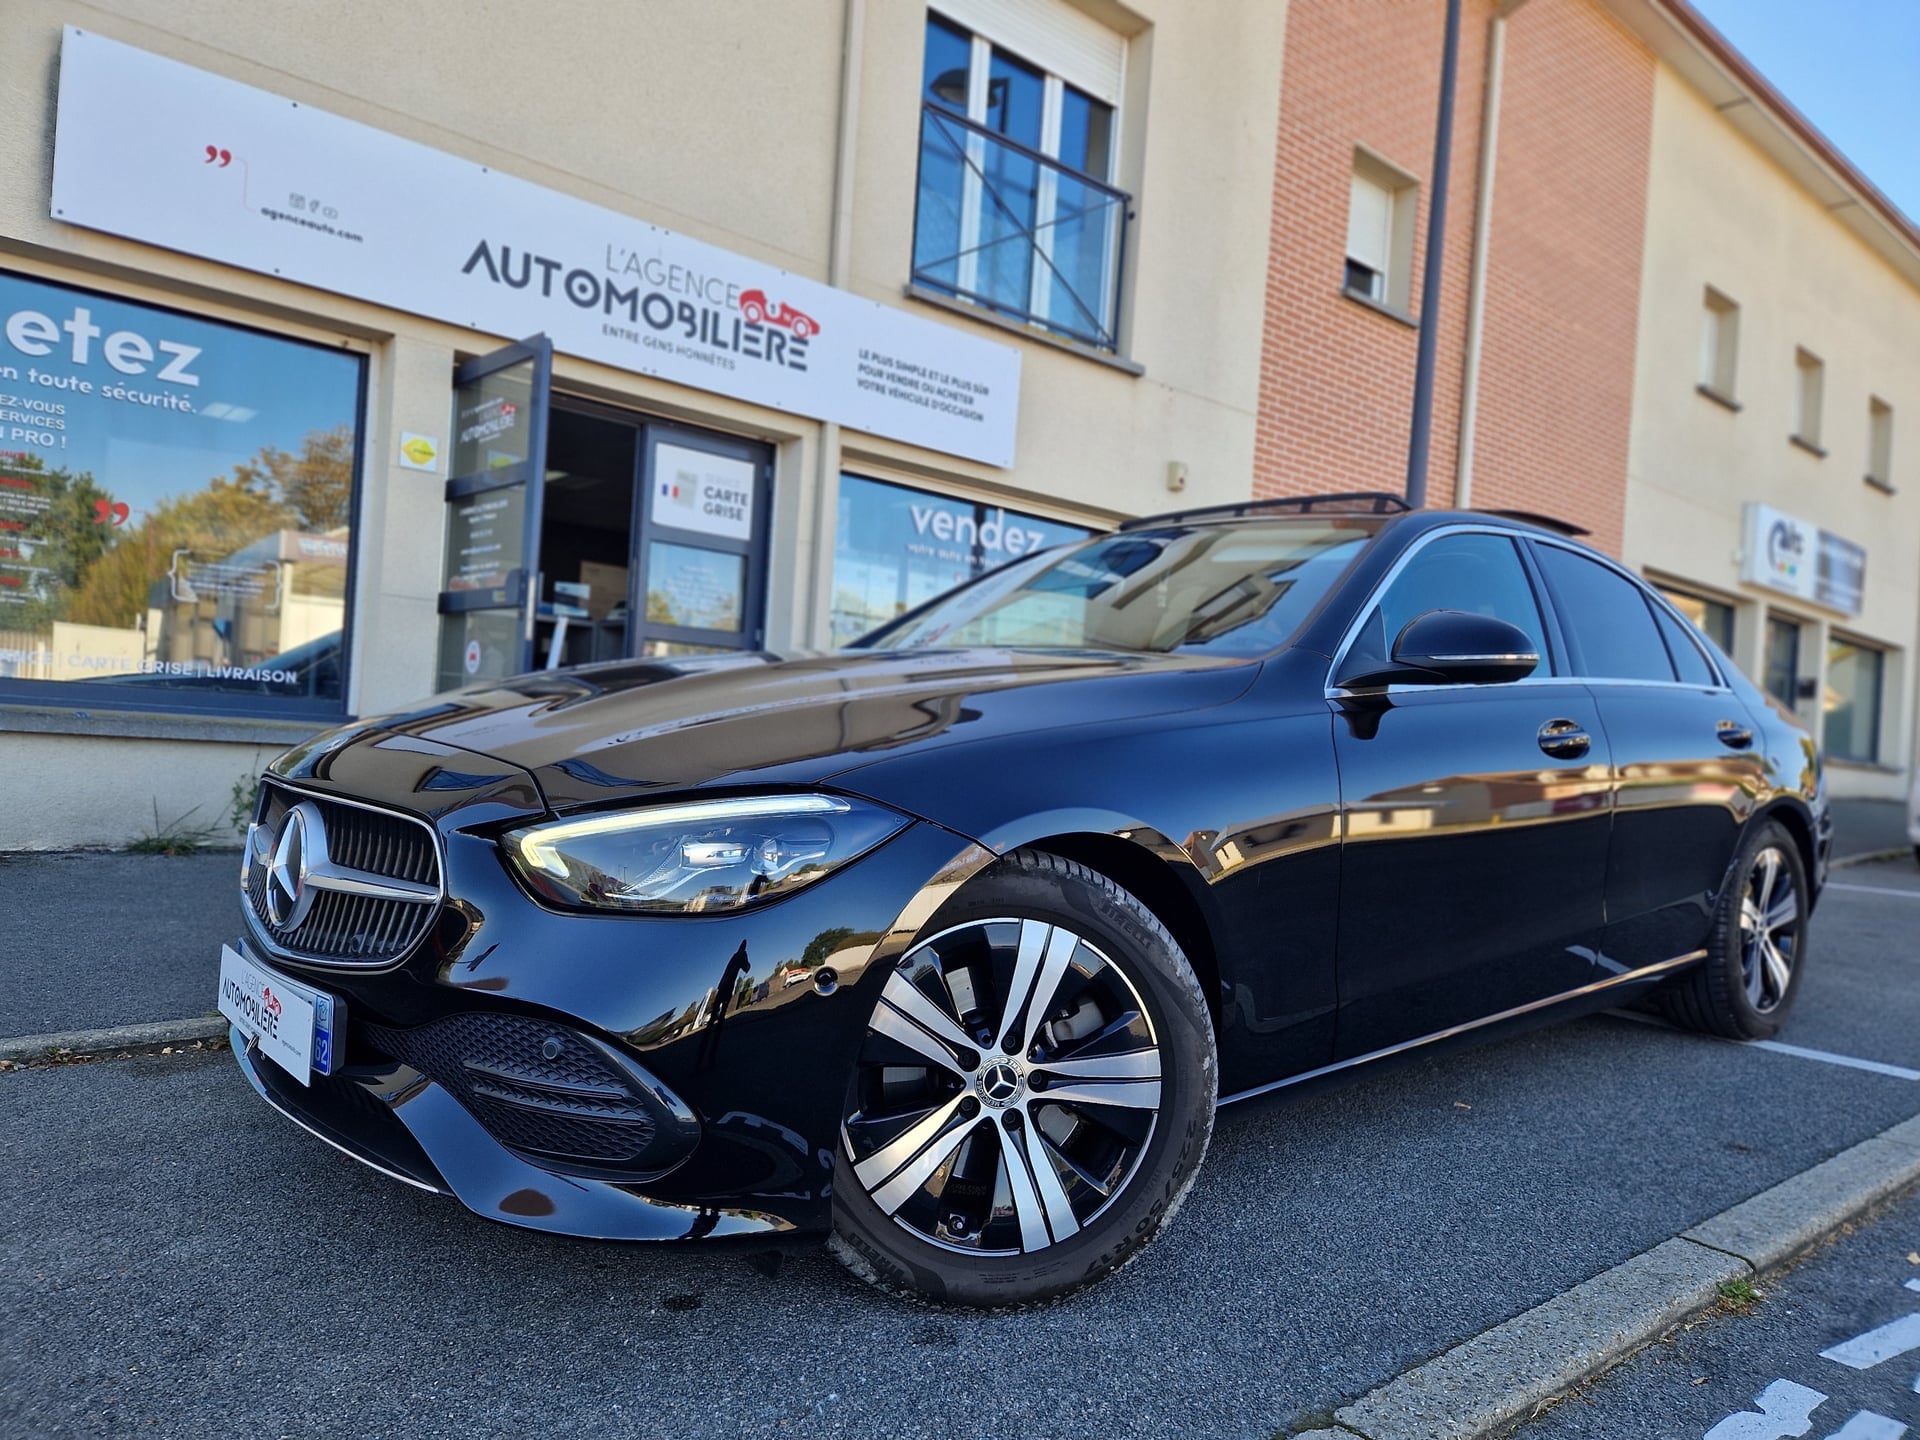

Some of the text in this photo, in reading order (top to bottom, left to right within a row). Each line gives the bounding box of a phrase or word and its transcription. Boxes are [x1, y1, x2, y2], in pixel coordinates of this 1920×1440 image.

[605, 244, 740, 310] L'AGENCE
[602, 323, 736, 371] ENTRE GENS HONNÊTES
[28, 367, 93, 394] toute
[102, 381, 199, 415] sécurité.
[858, 349, 869, 360] LE
[871, 352, 894, 367] PLUS
[895, 360, 927, 378] SIMPLE
[928, 370, 939, 380] ET
[940, 374, 951, 385] LE
[952, 376, 973, 391] PLUS
[858, 363, 975, 405] POUR VENDRE OU ACHETER
[857, 378, 985, 422] VOTRE VÉHICULE D'OCCASION
[11, 427, 55, 447] PRO
[703, 503, 744, 522] GRISE
[704, 486, 749, 507] CARTE
[911, 505, 1045, 556] vendez
[138, 660, 193, 676] GRISE
[206, 668, 298, 684] LIVRAISON
[315, 1036, 328, 1065] 62
